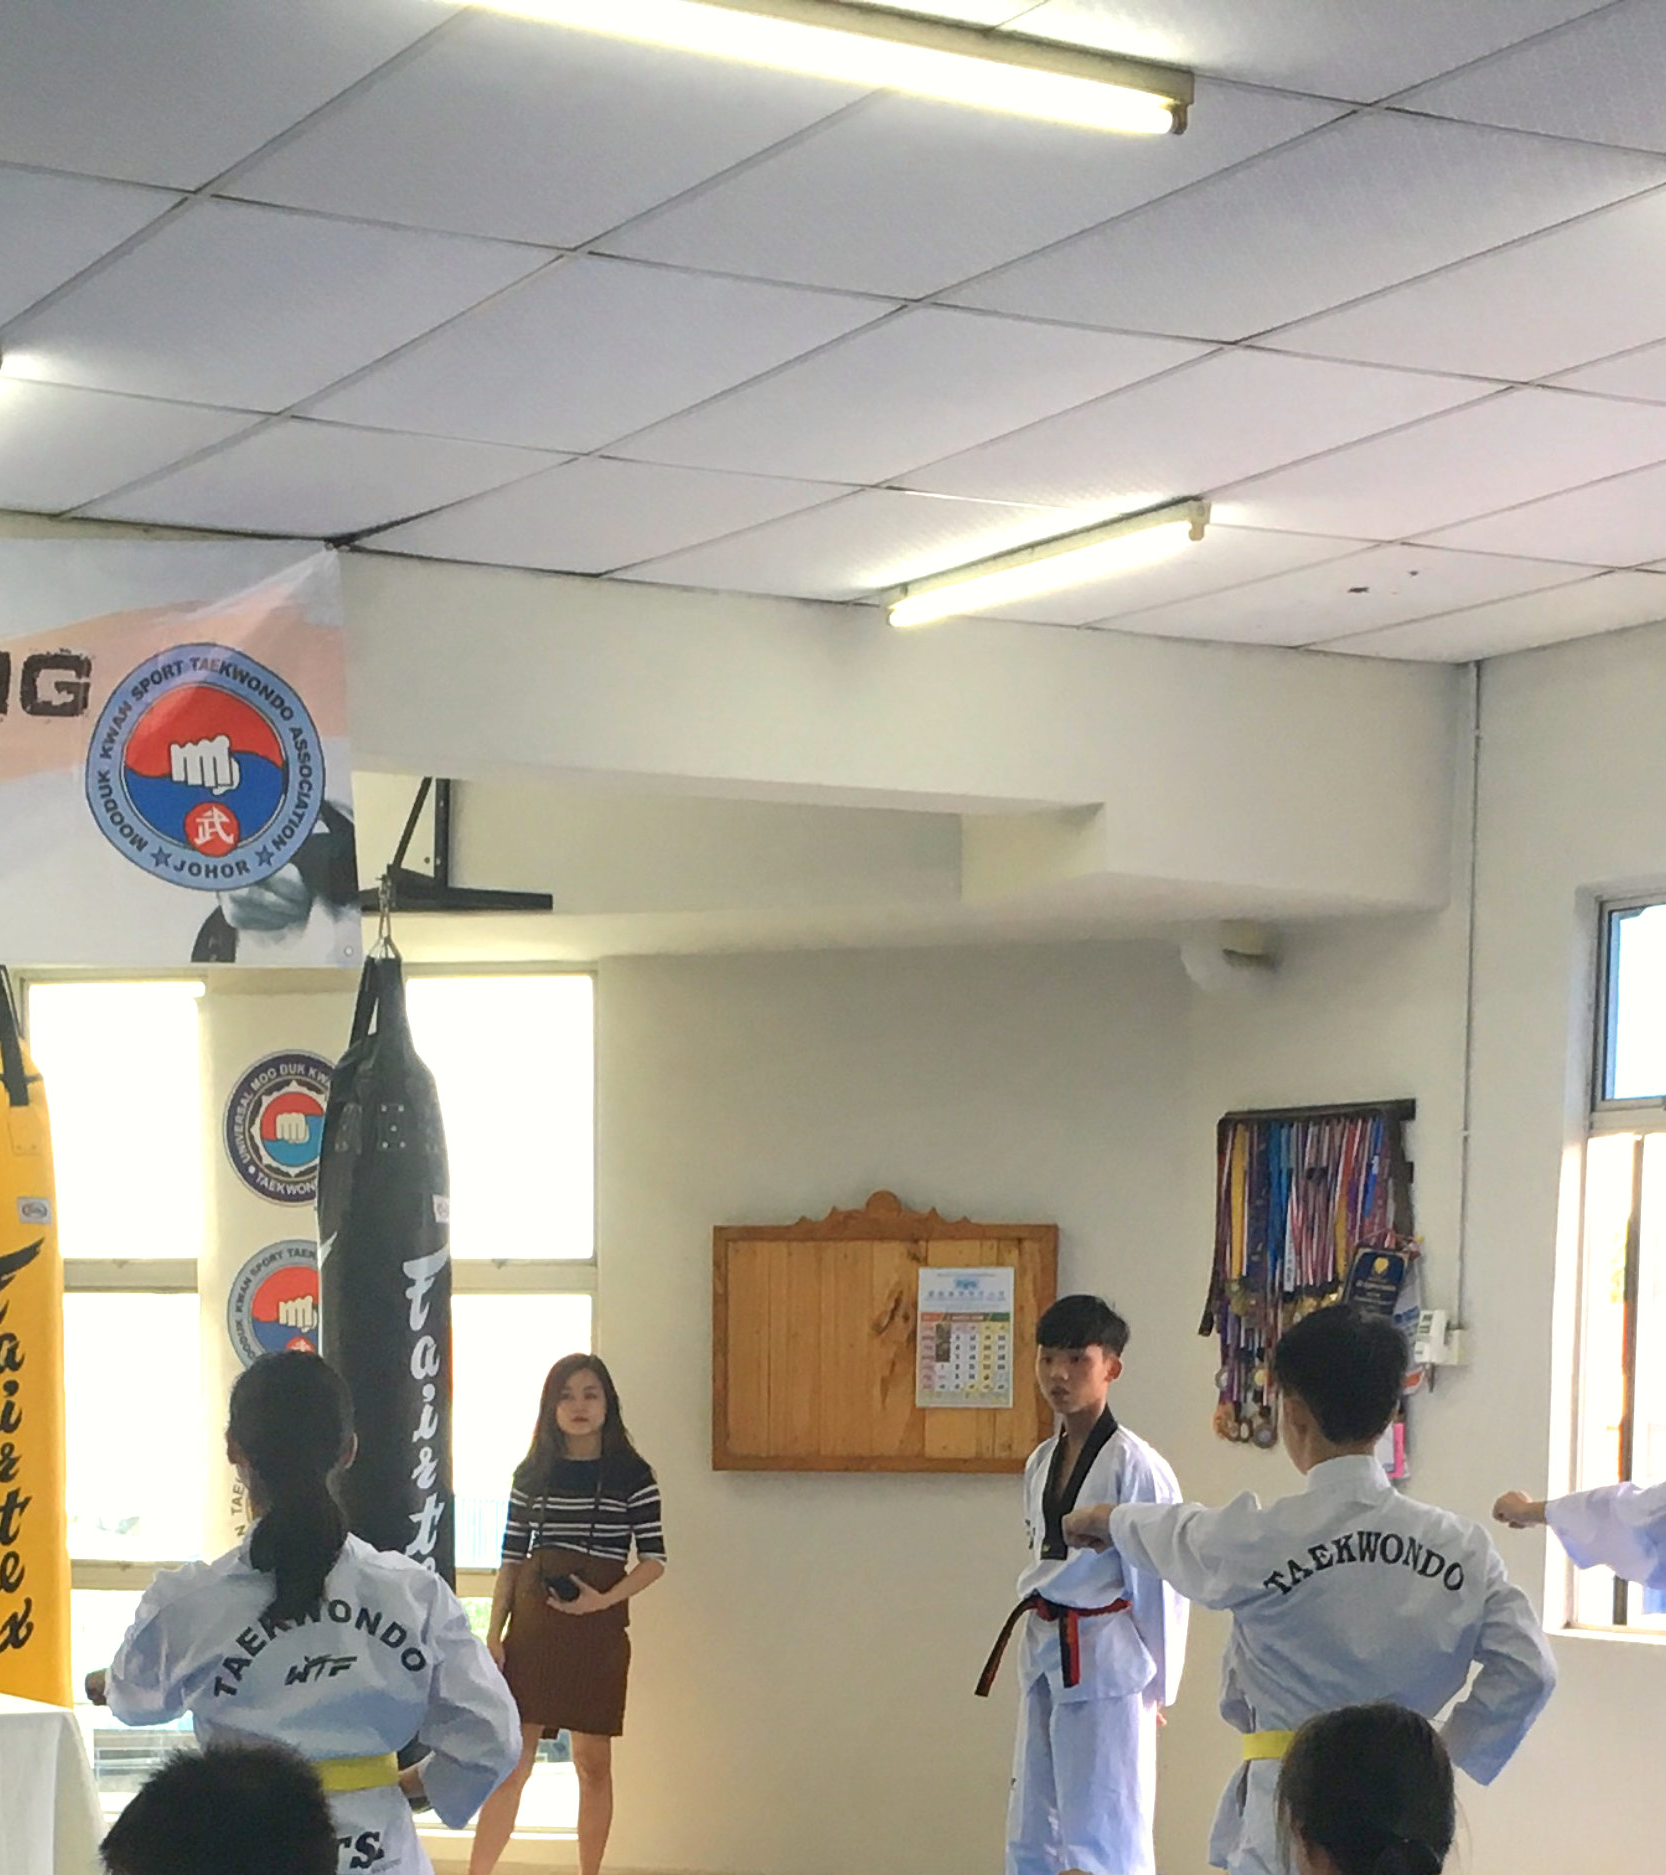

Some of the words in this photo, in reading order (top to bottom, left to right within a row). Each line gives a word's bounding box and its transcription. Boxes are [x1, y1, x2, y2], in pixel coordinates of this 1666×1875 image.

[131, 660, 184, 701] SPORT
[189, 657, 294, 722] TAEKWONDO
[100, 701, 132, 759] KWAN
[97, 768, 148, 852] MOODUK
[271, 726, 313, 851] ASSOCIATION
[173, 860, 251, 879] JOHOR
[234, 1092, 253, 1163] UNIVERSAL
[251, 1068, 277, 1091] MOO
[402, 1242, 450, 1576] Fairt
[1263, 1530, 1464, 1595] TAEKWONDO
